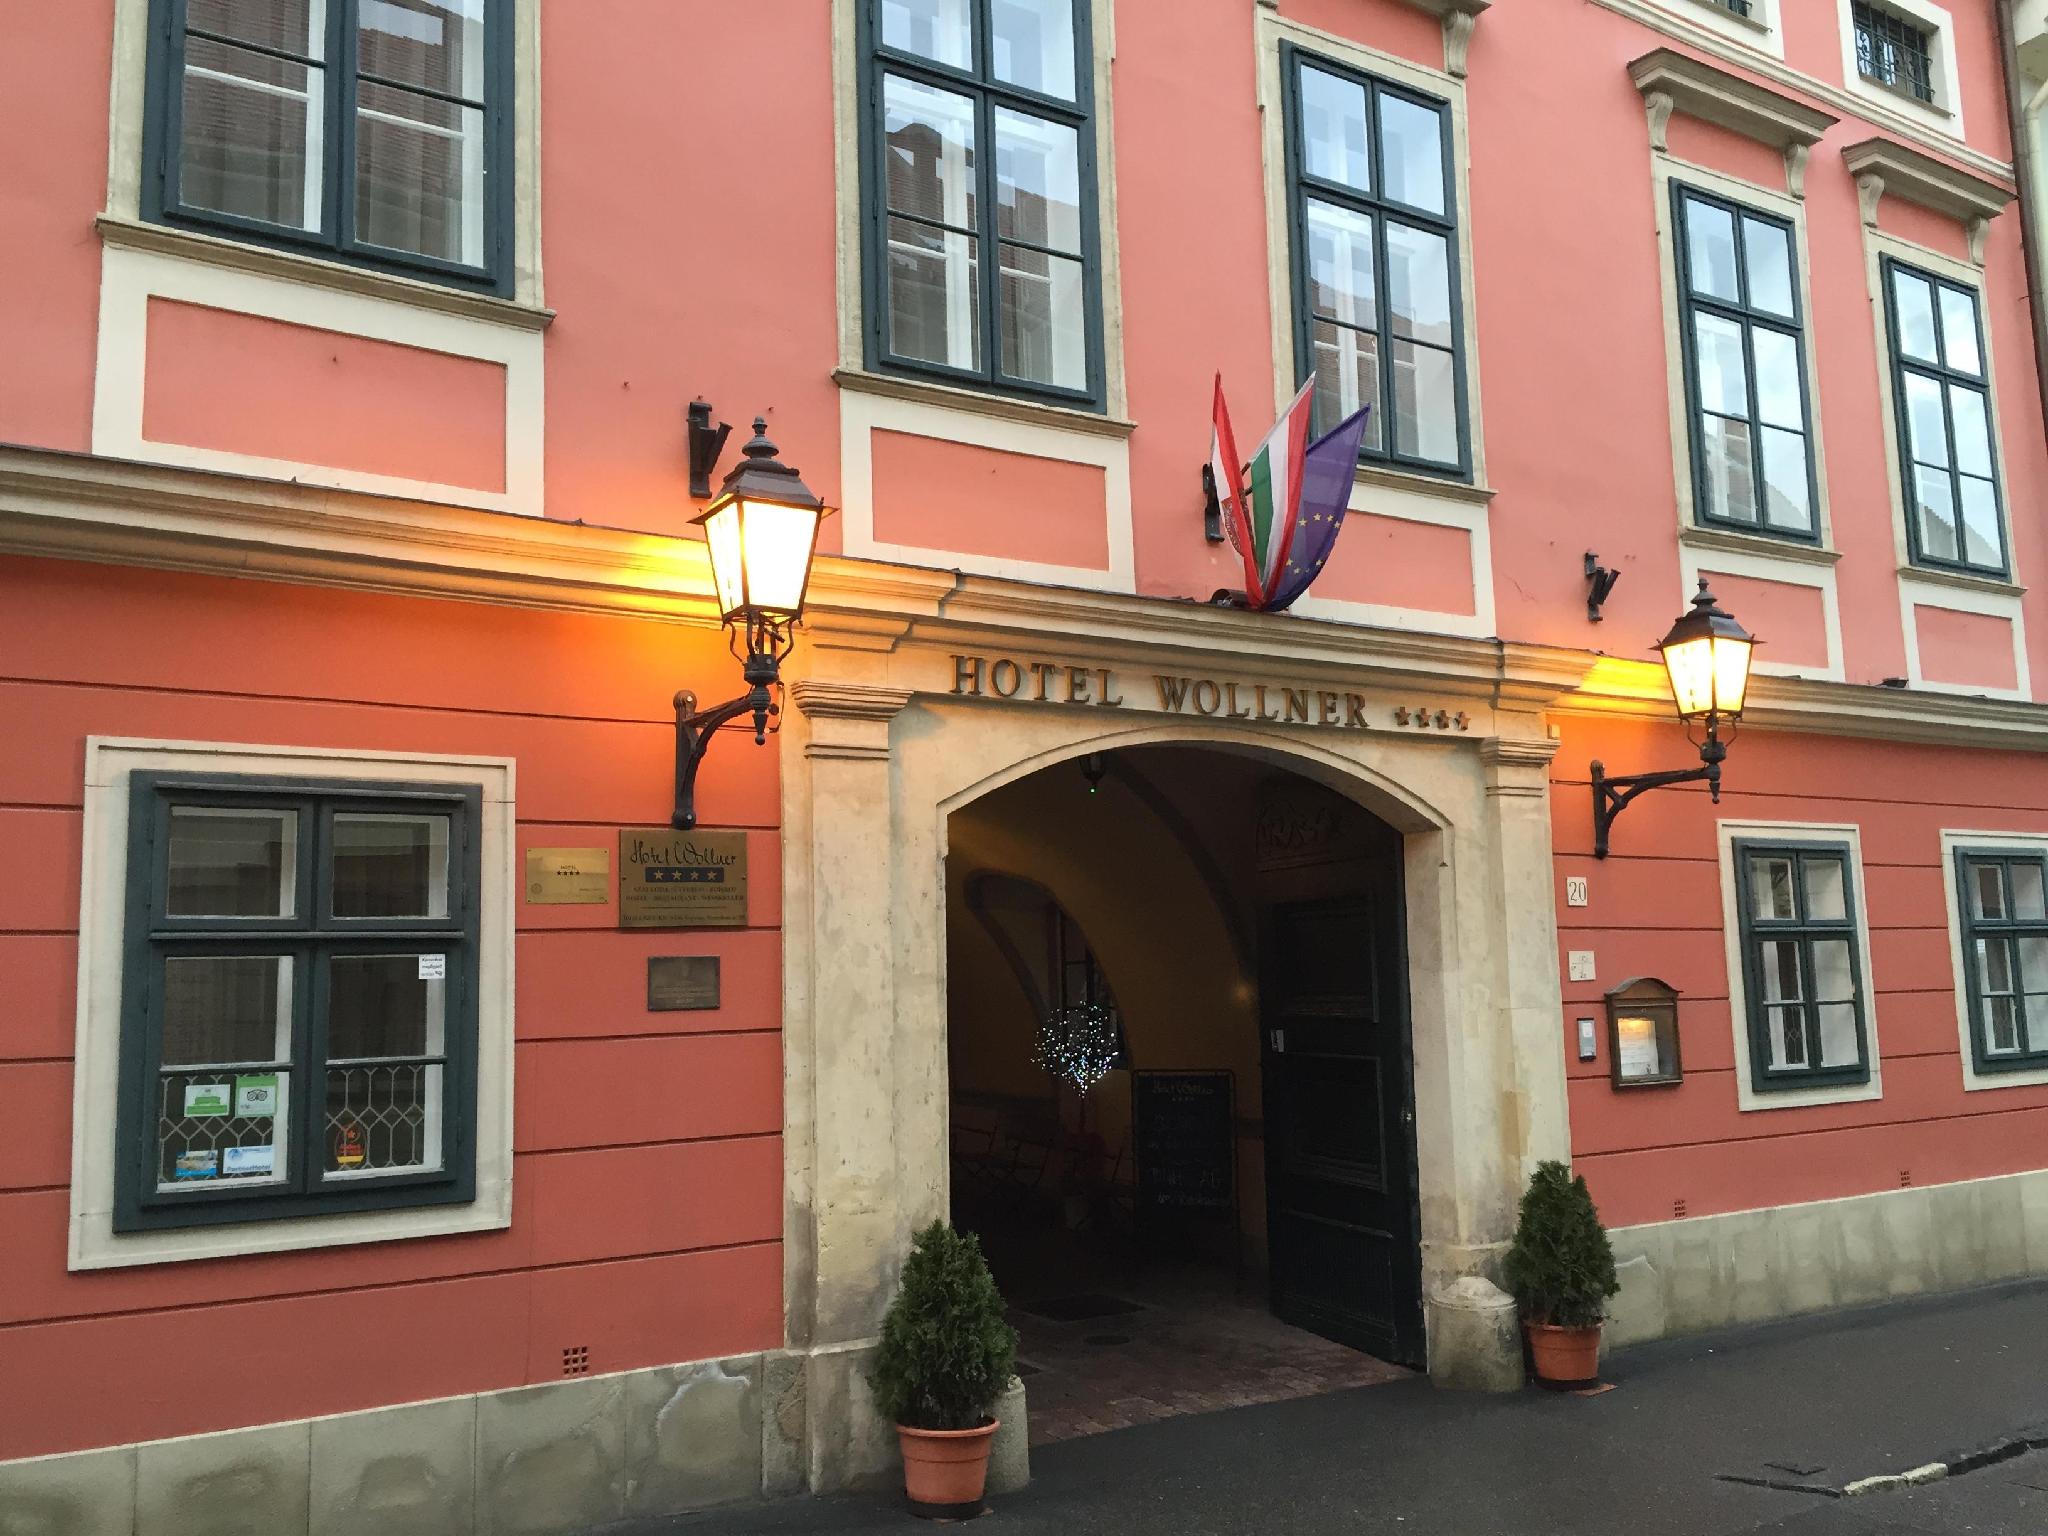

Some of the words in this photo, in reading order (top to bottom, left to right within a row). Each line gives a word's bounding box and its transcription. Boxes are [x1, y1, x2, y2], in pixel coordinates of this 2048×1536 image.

[950, 655, 1123, 706] HOTEL
[1152, 675, 1370, 728] WOLLNER
[630, 840, 669, 865] Hotel
[673, 840, 736, 865] Wollner
[1569, 881, 1586, 901] 20
